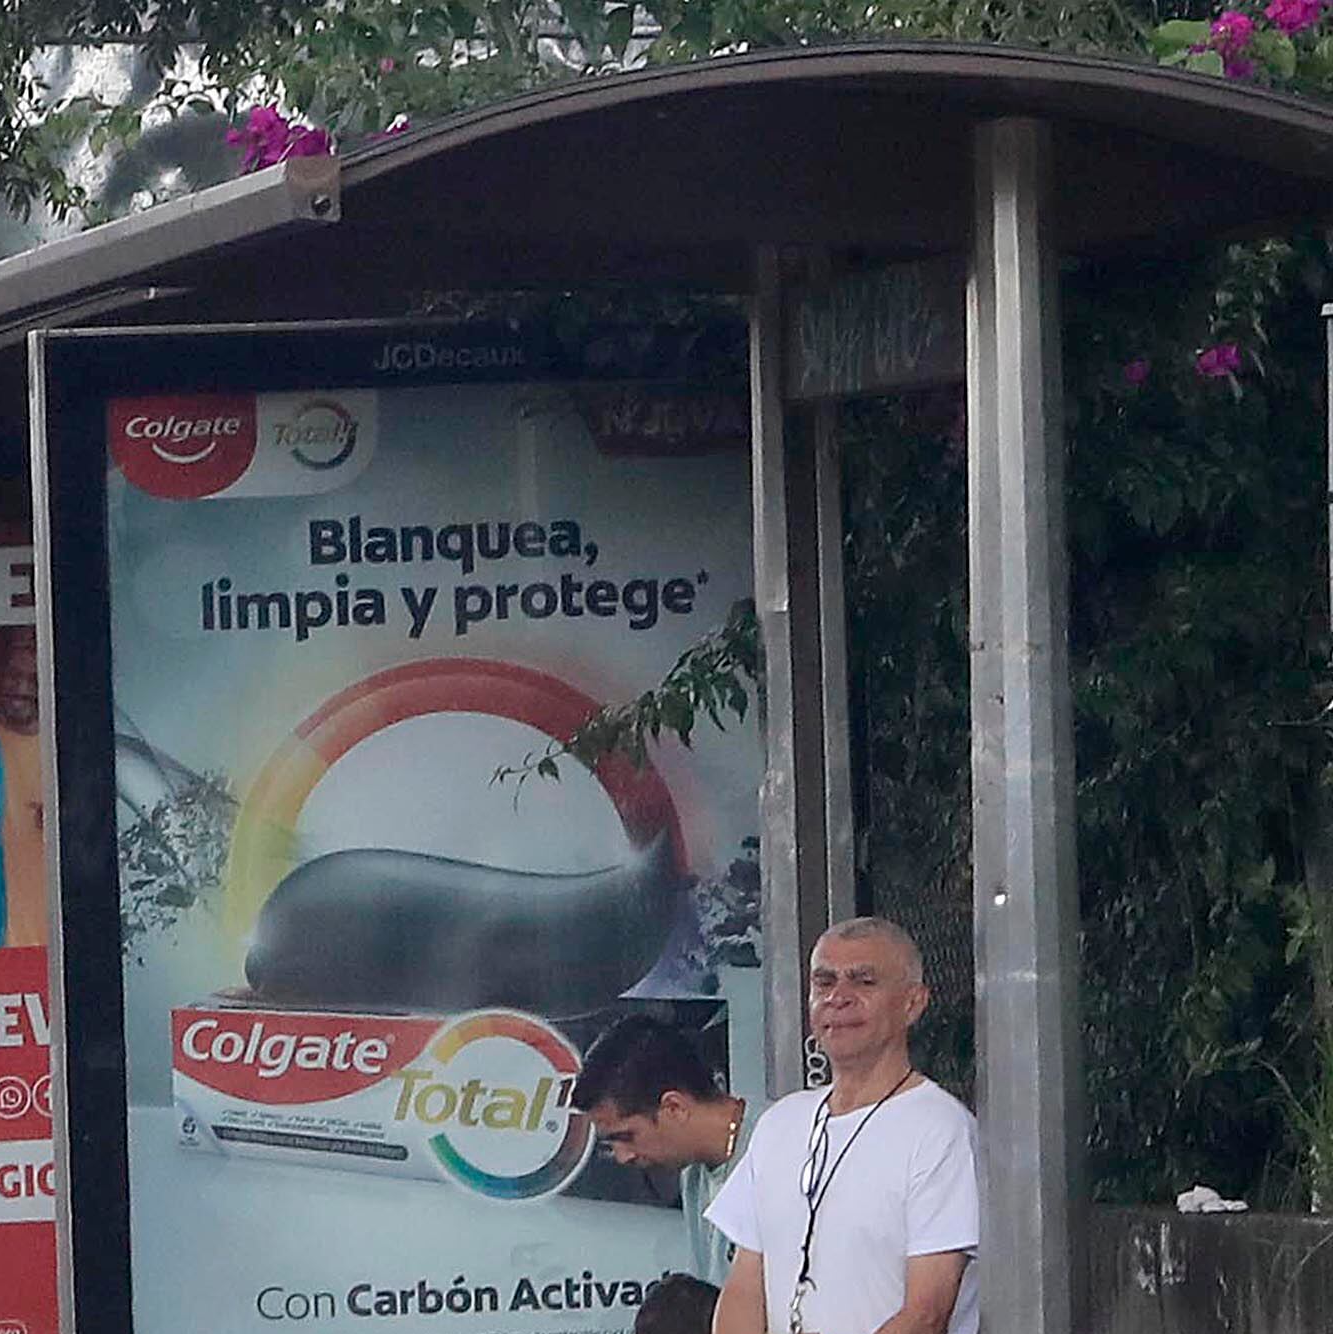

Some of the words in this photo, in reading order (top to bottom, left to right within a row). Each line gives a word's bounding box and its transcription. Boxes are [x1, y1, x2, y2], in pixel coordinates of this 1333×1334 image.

[373, 342, 526, 371] JCDecaux
[125, 415, 242, 443] Colgate
[308, 515, 599, 575] Blanquea,
[201, 573, 387, 642] limpia
[400, 585, 439, 640] y
[181, 1018, 389, 1078] Colgate
[256, 1286, 336, 1321] Con
[346, 1273, 499, 1318] Carbón
[509, 1270, 669, 1312] Activa
